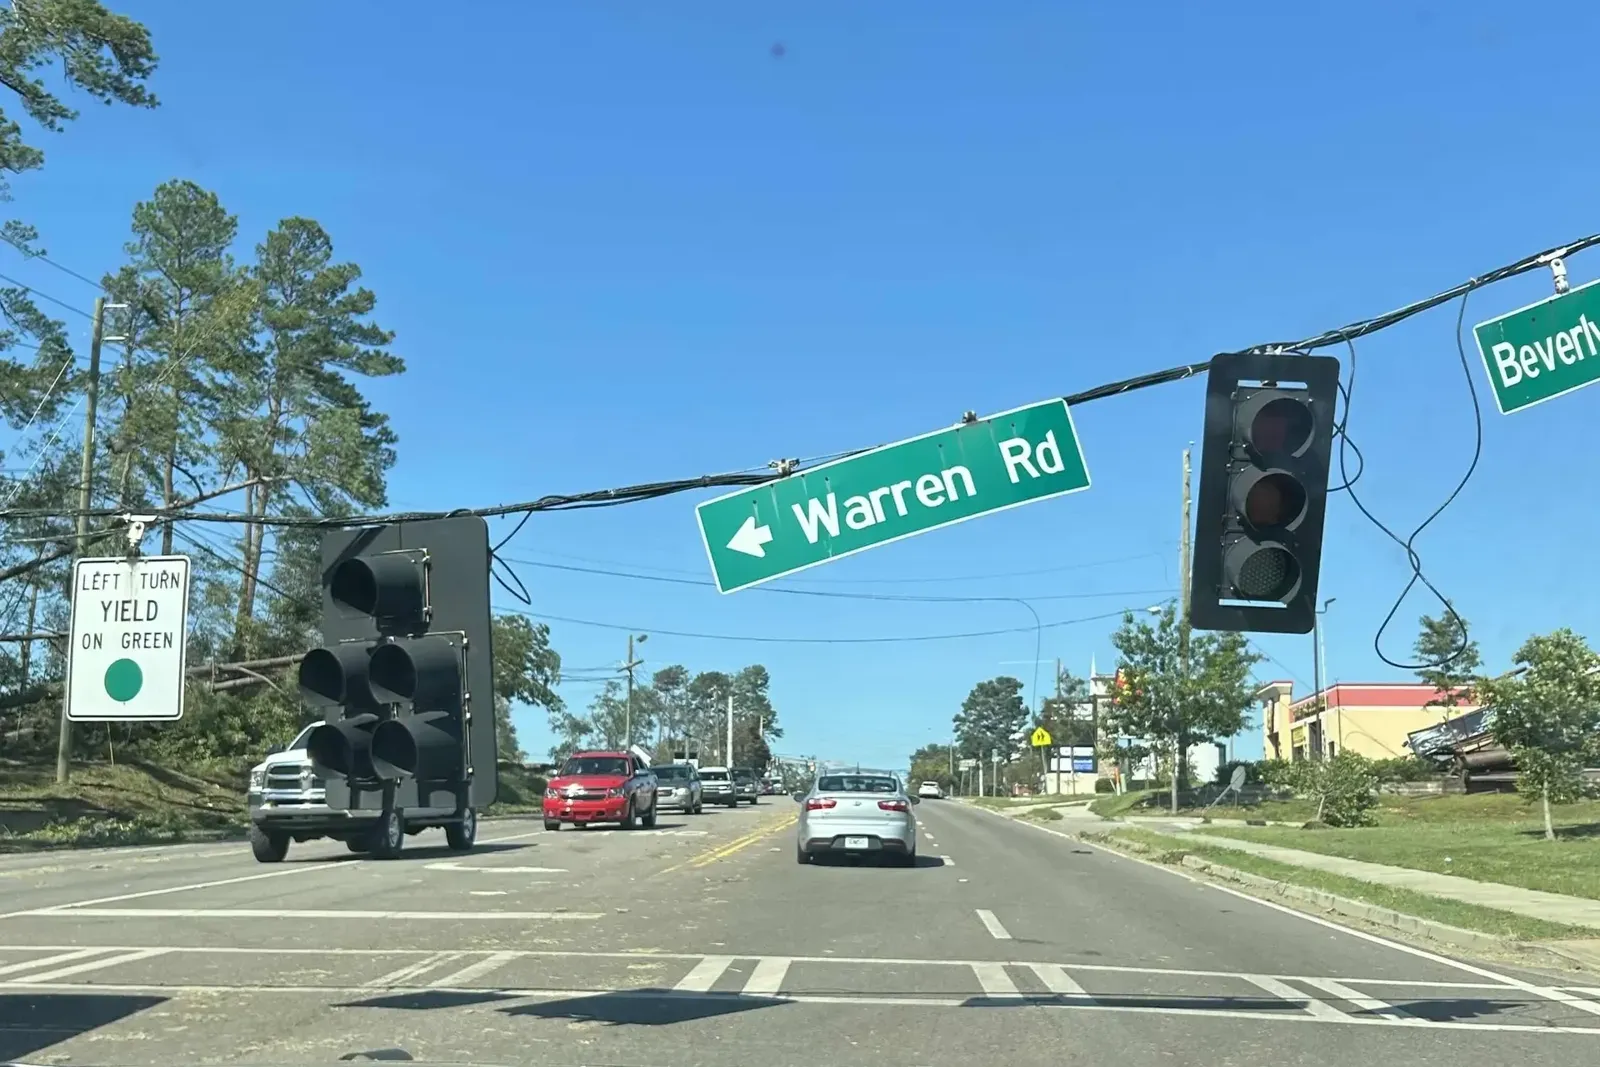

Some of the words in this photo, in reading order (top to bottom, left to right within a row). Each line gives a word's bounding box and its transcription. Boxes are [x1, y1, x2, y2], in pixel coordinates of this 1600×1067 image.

[791, 465, 977, 544] Warren
[998, 429, 1065, 484] Rd
[82, 573, 121, 591] LEFT
[140, 572, 180, 590] TURN
[101, 599, 159, 622] YIELD
[82, 633, 103, 650] ON
[121, 632, 173, 649] GREEN
